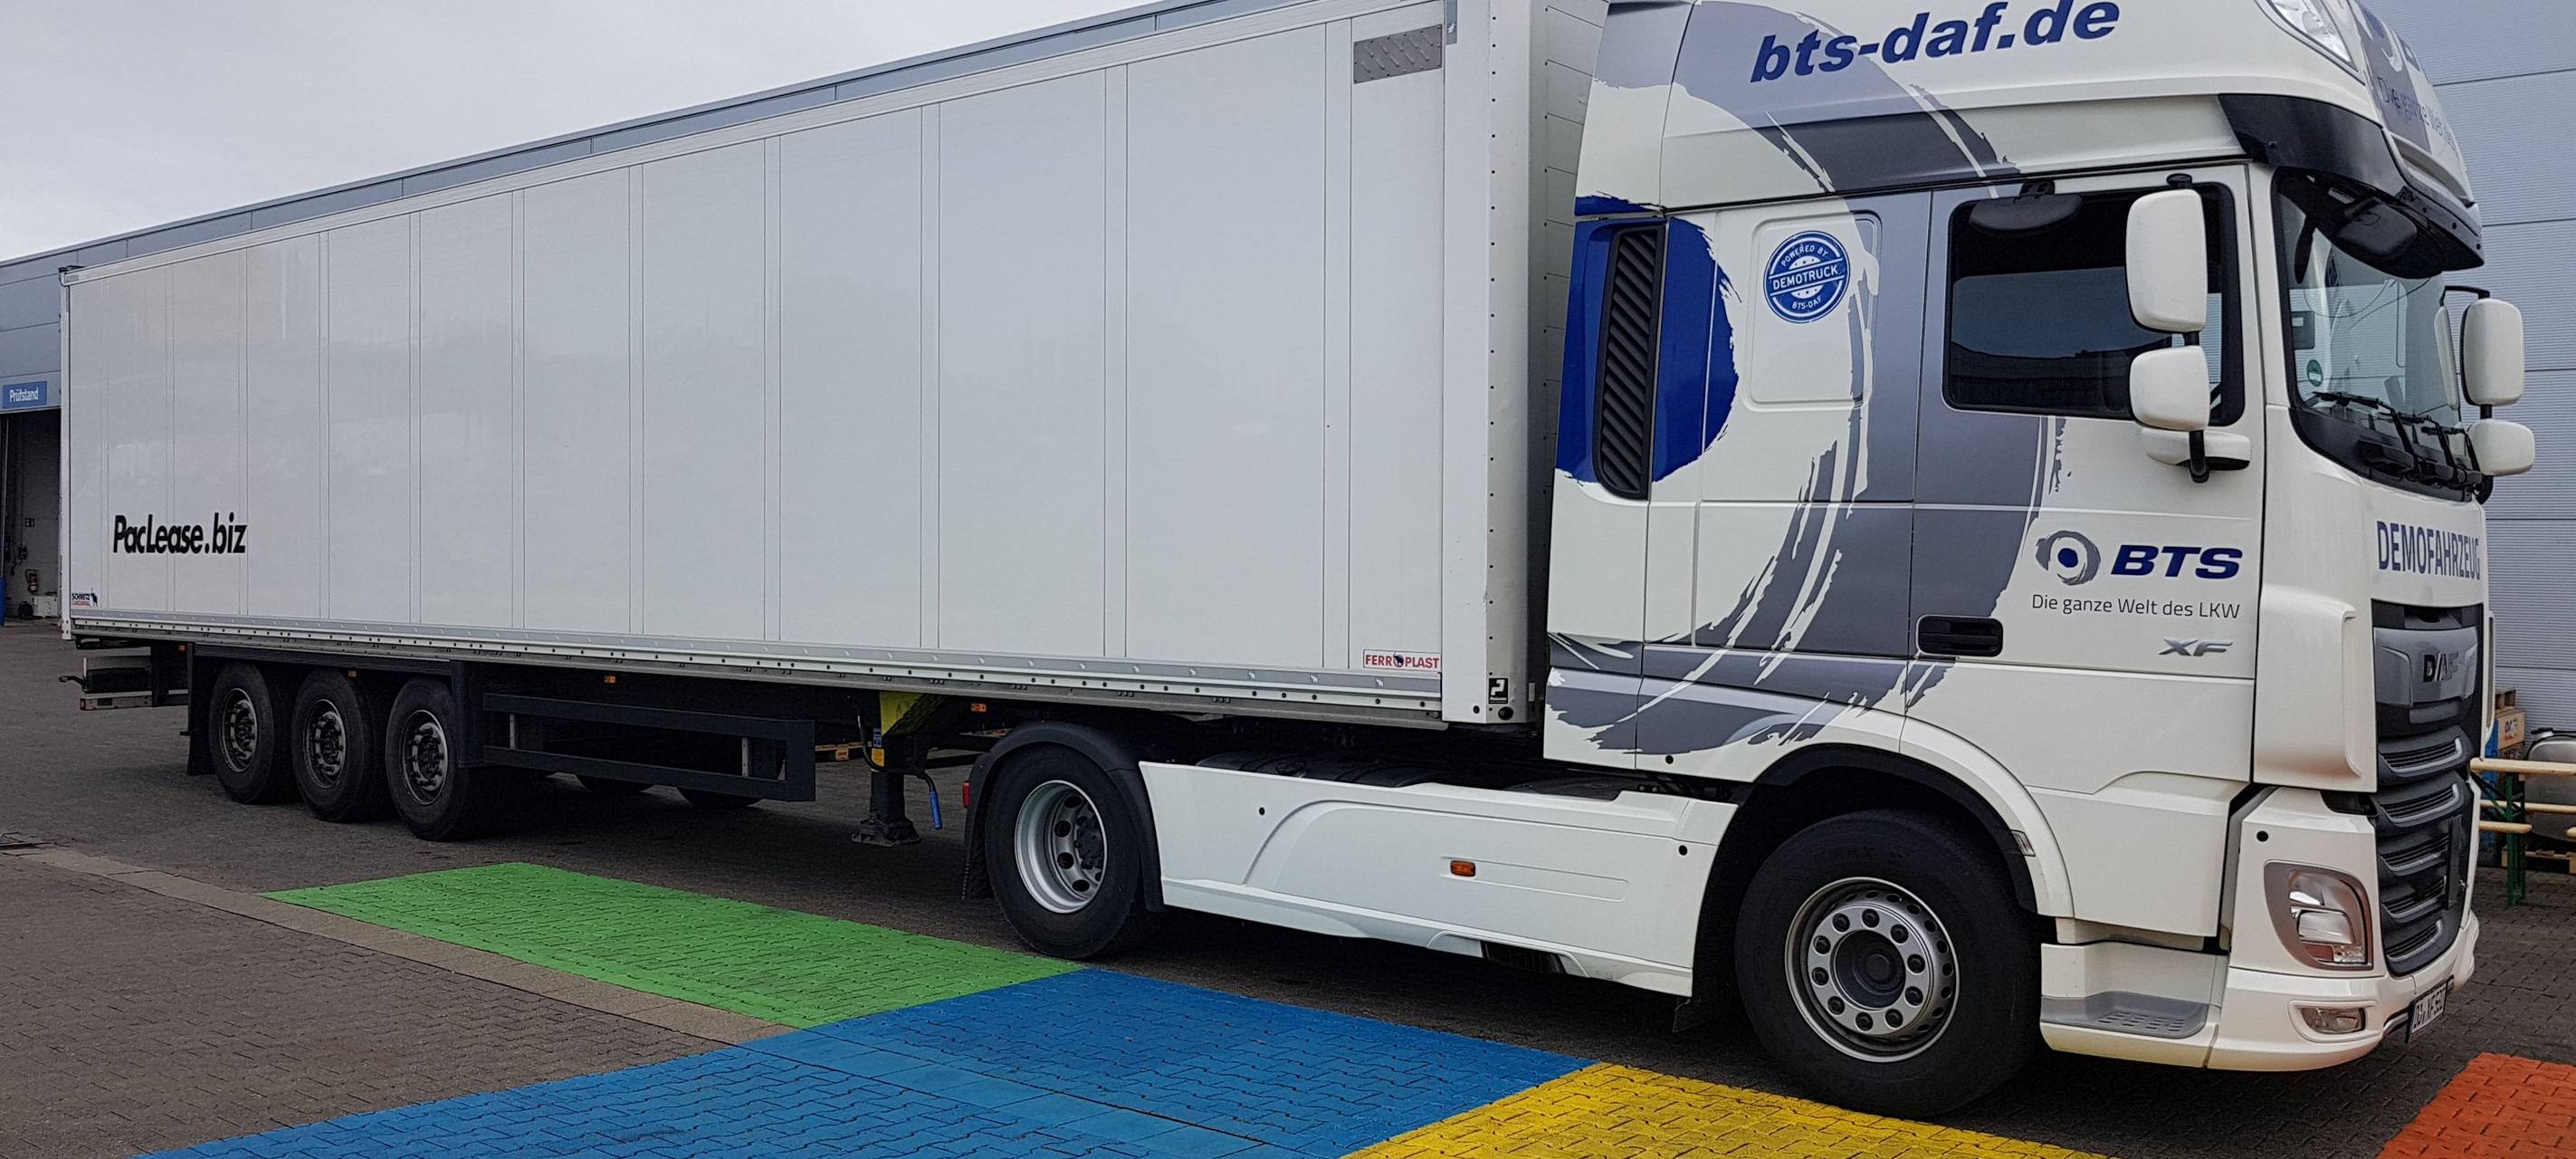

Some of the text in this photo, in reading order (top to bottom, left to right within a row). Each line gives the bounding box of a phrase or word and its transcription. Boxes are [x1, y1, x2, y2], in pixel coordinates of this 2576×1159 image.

[1750, 0, 2121, 83] bts-daf.de
[1780, 244, 1829, 266] POWERED BY
[1773, 264, 1838, 290] DEMOTRUCK
[1791, 295, 1823, 310] BTS-DAF
[9, 387, 39, 403] Prüfstand
[113, 512, 248, 554] PacLease.biz
[2110, 544, 2244, 580] BTS
[2376, 521, 2481, 580] DEMOFAHRZEUG
[2032, 594, 2240, 618] Die ganze Welt des LKW
[2158, 637, 2234, 657] XF
